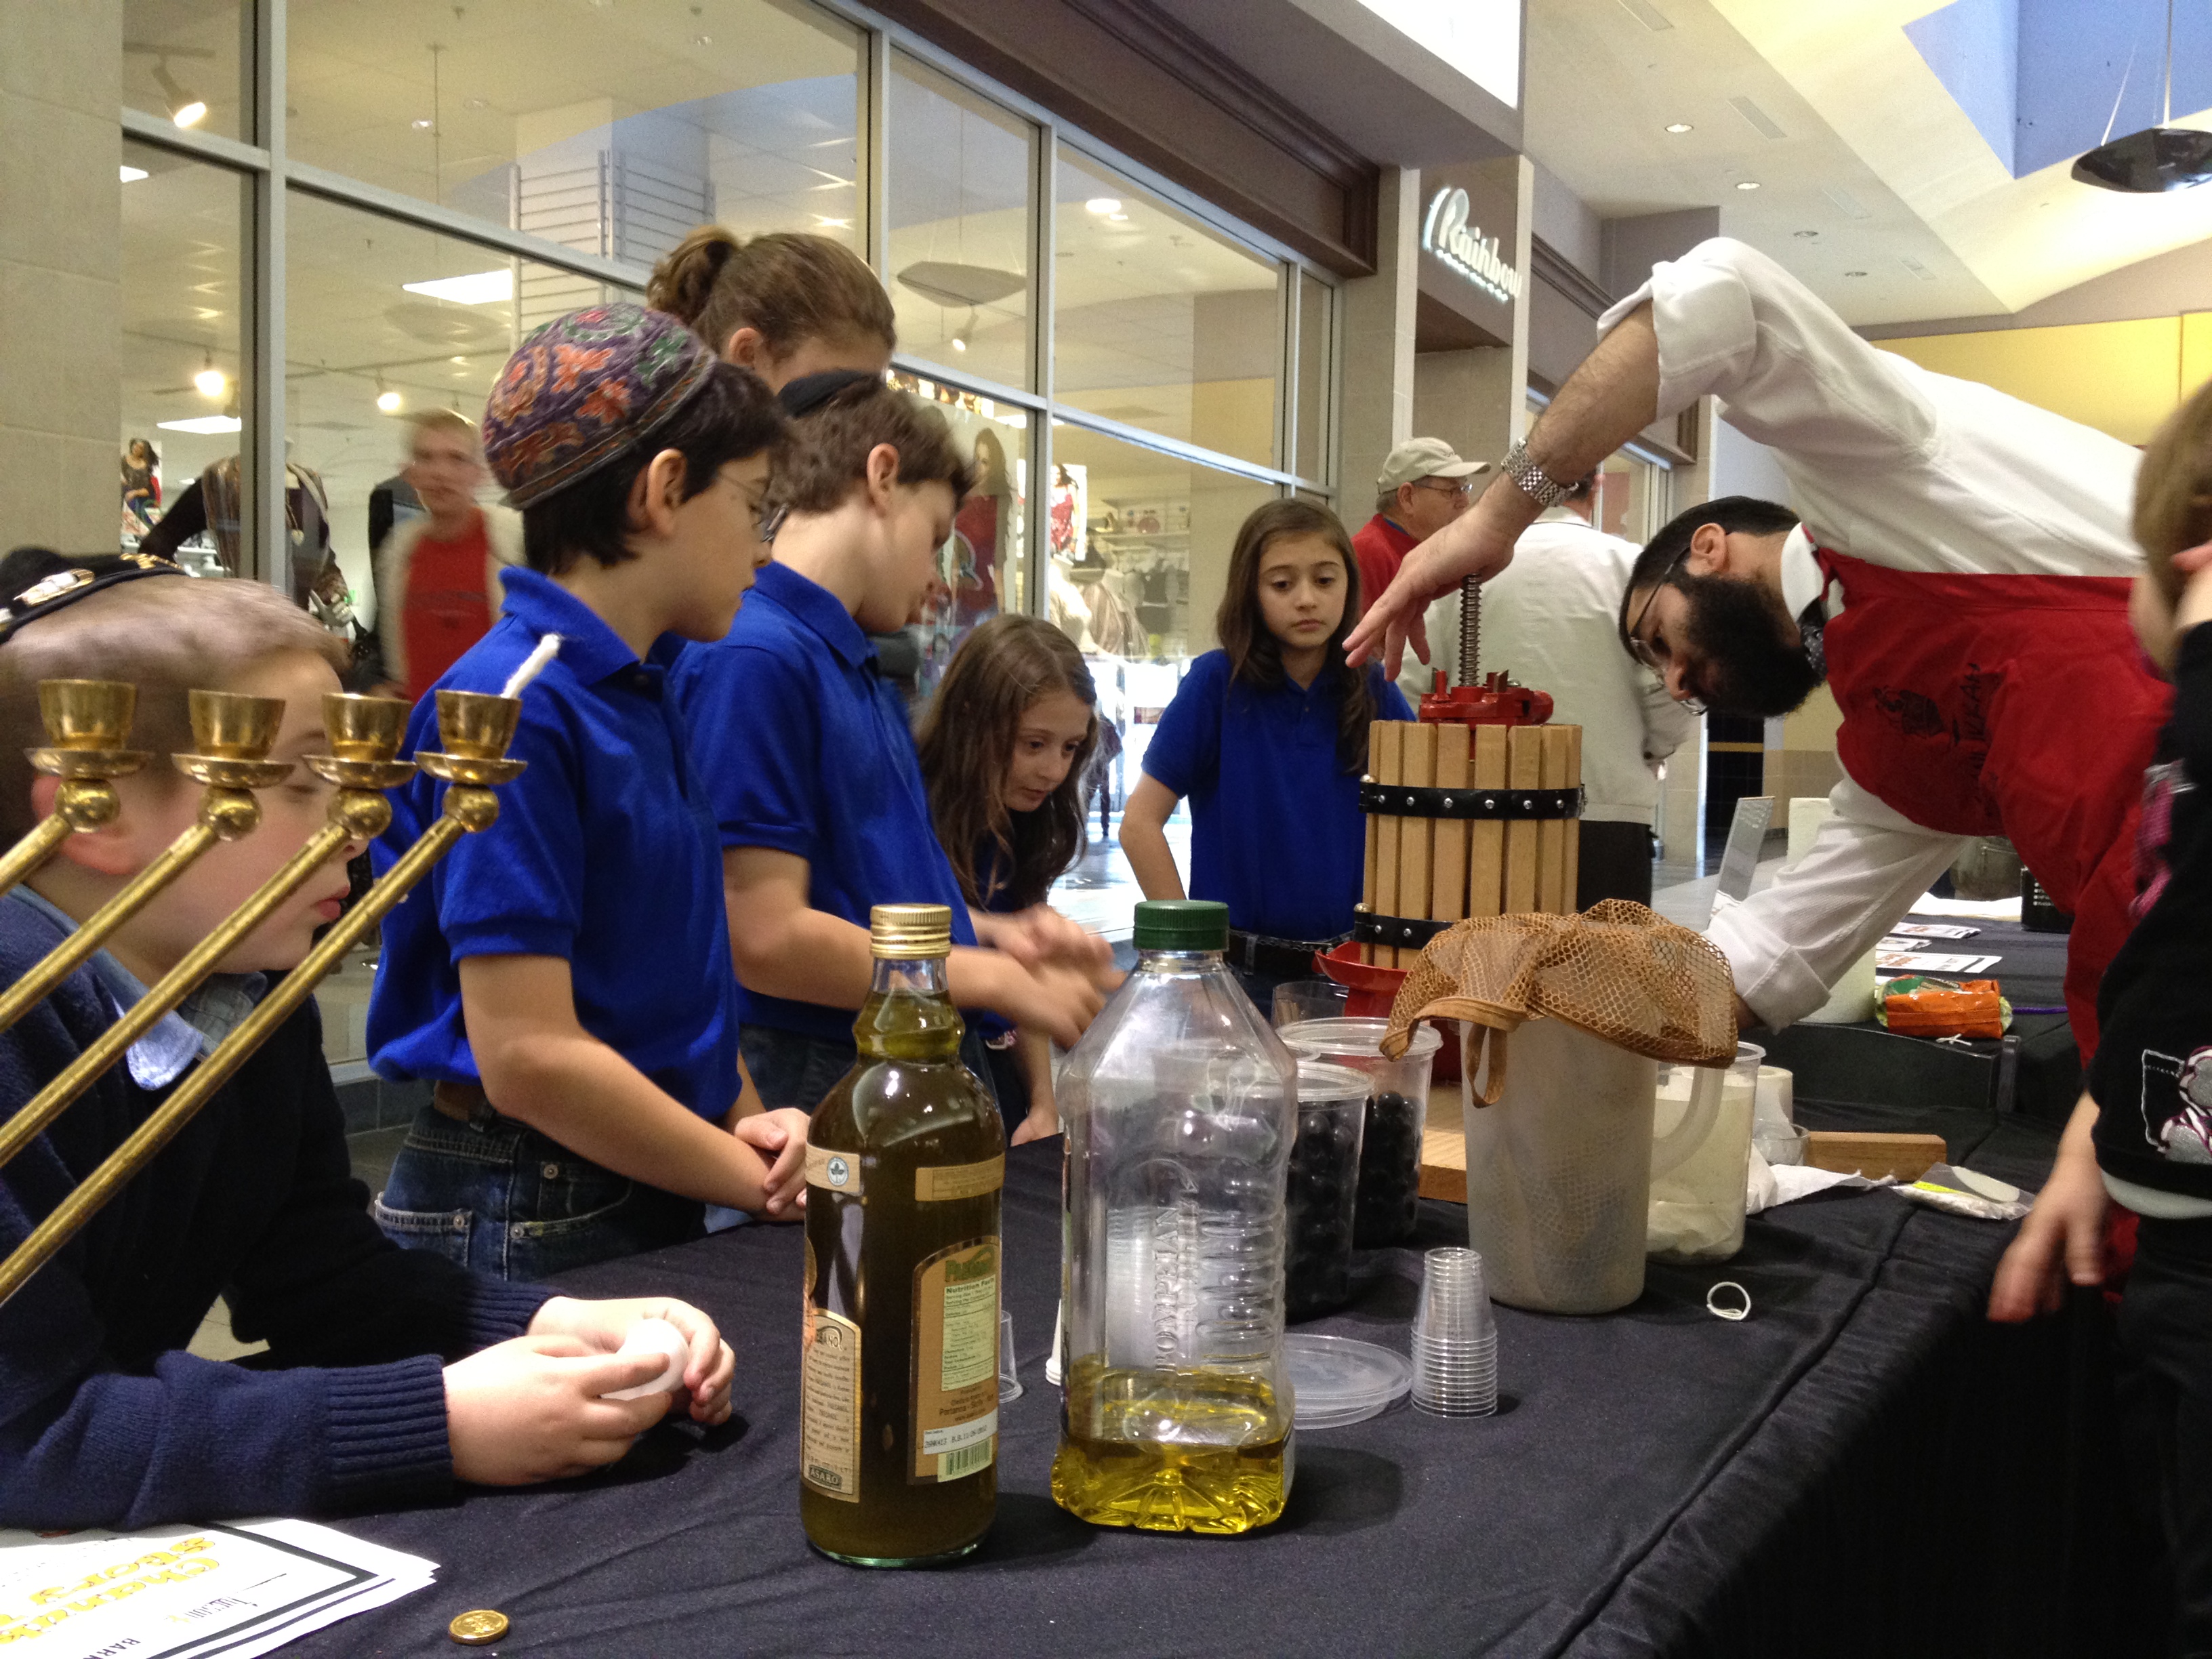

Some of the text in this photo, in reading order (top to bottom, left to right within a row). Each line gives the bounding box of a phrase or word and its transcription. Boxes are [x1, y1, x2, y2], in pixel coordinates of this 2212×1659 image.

[1422, 184, 1522, 299] Rainbow
[1153, 1206, 1178, 1372] POMPEIAN
[810, 1467, 838, 1485] ASARO
